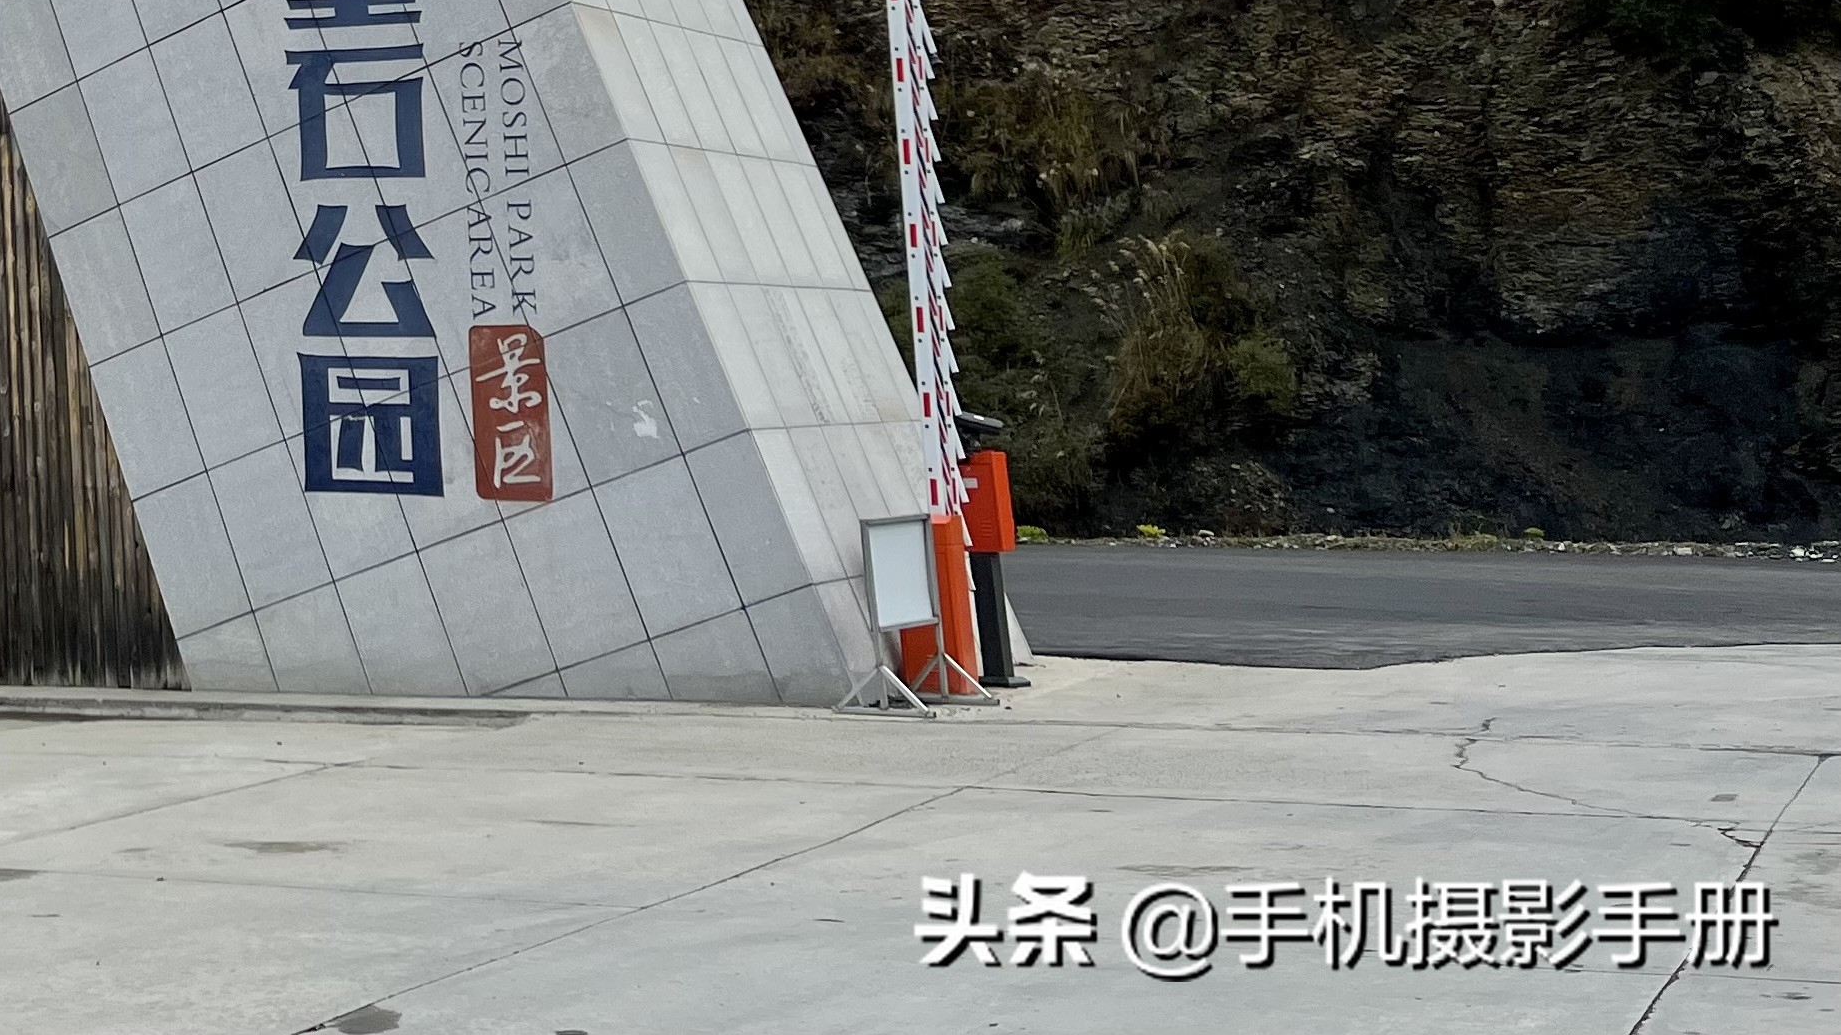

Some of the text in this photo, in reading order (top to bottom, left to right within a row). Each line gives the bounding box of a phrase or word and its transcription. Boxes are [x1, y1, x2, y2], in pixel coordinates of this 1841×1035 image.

[459, 41, 497, 320] SCENIC AREA
[497, 39, 538, 315] MOSHI PARK
[475, 332, 543, 489] 景区
